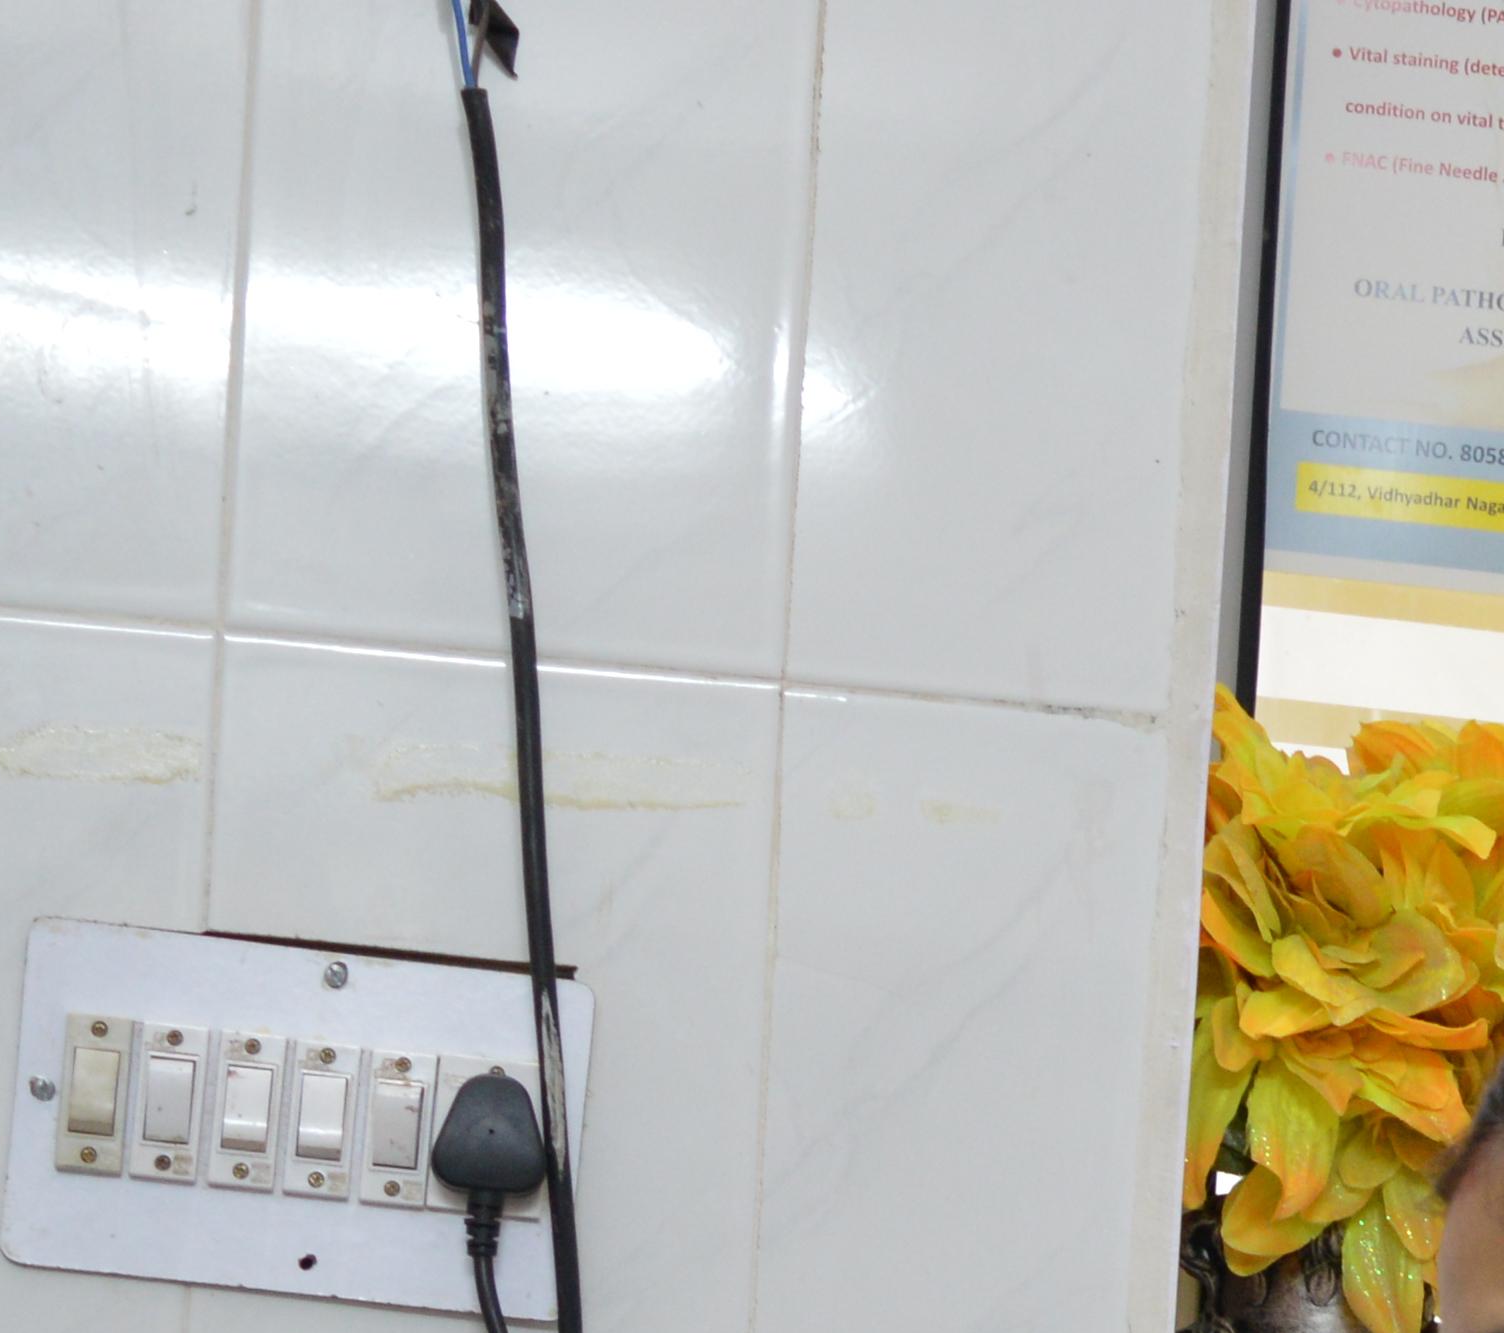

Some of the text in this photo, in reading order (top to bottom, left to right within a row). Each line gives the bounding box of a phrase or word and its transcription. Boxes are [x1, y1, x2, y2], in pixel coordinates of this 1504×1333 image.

[1349, 46, 1388, 63] Vital
[1393, 49, 1459, 75] staining
[1345, 99, 1426, 122] condition
[1431, 111, 1452, 124] on
[1457, 110, 1493, 129] vital
[1341, 151, 1387, 171] FNAC
[1392, 157, 1435, 177] (Fine
[1439, 162, 1498, 183] Needle
[1353, 278, 1425, 303] ORAL
[1312, 428, 1410, 455] CONTACT
[1415, 439, 1453, 461] NO.
[1308, 479, 1362, 501] 4/112,
[1367, 485, 1461, 510] Vidhyadhar
